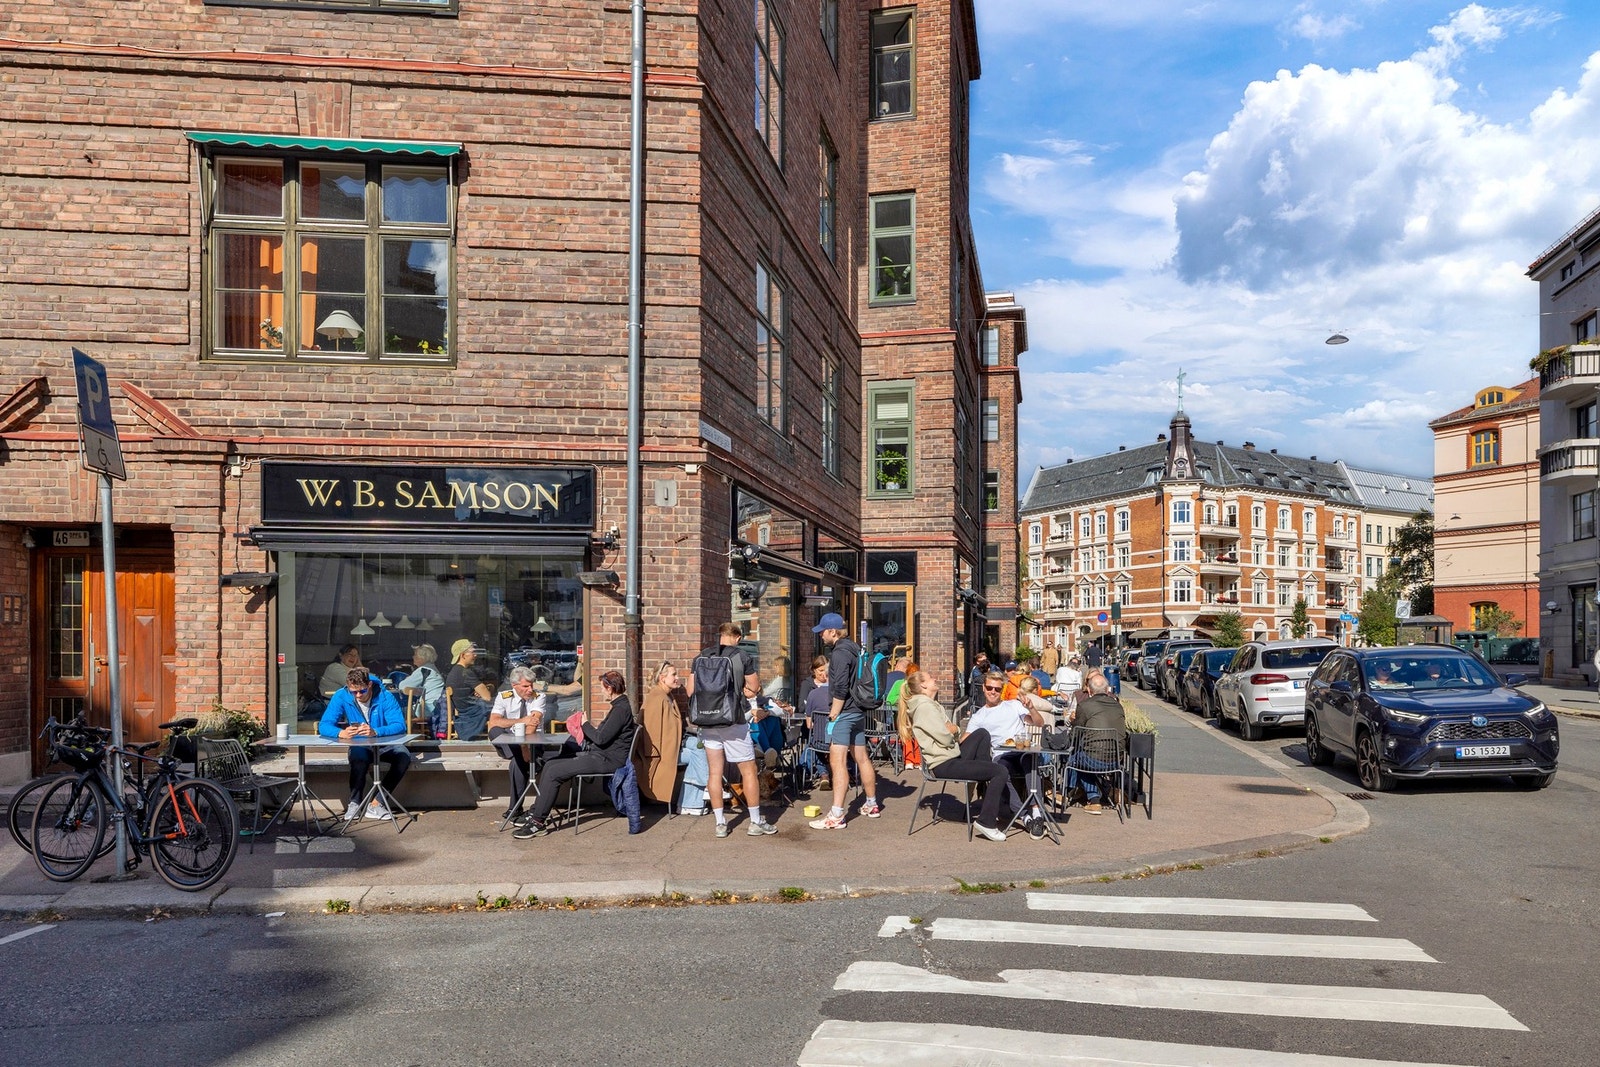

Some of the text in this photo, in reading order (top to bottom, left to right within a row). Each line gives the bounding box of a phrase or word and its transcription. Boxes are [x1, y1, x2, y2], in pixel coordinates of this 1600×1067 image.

[84, 365, 103, 421] P
[296, 478, 562, 511] W. B. SAMSON
[55, 532, 68, 544] 46
[1464, 746, 1507, 756] DS 15322
